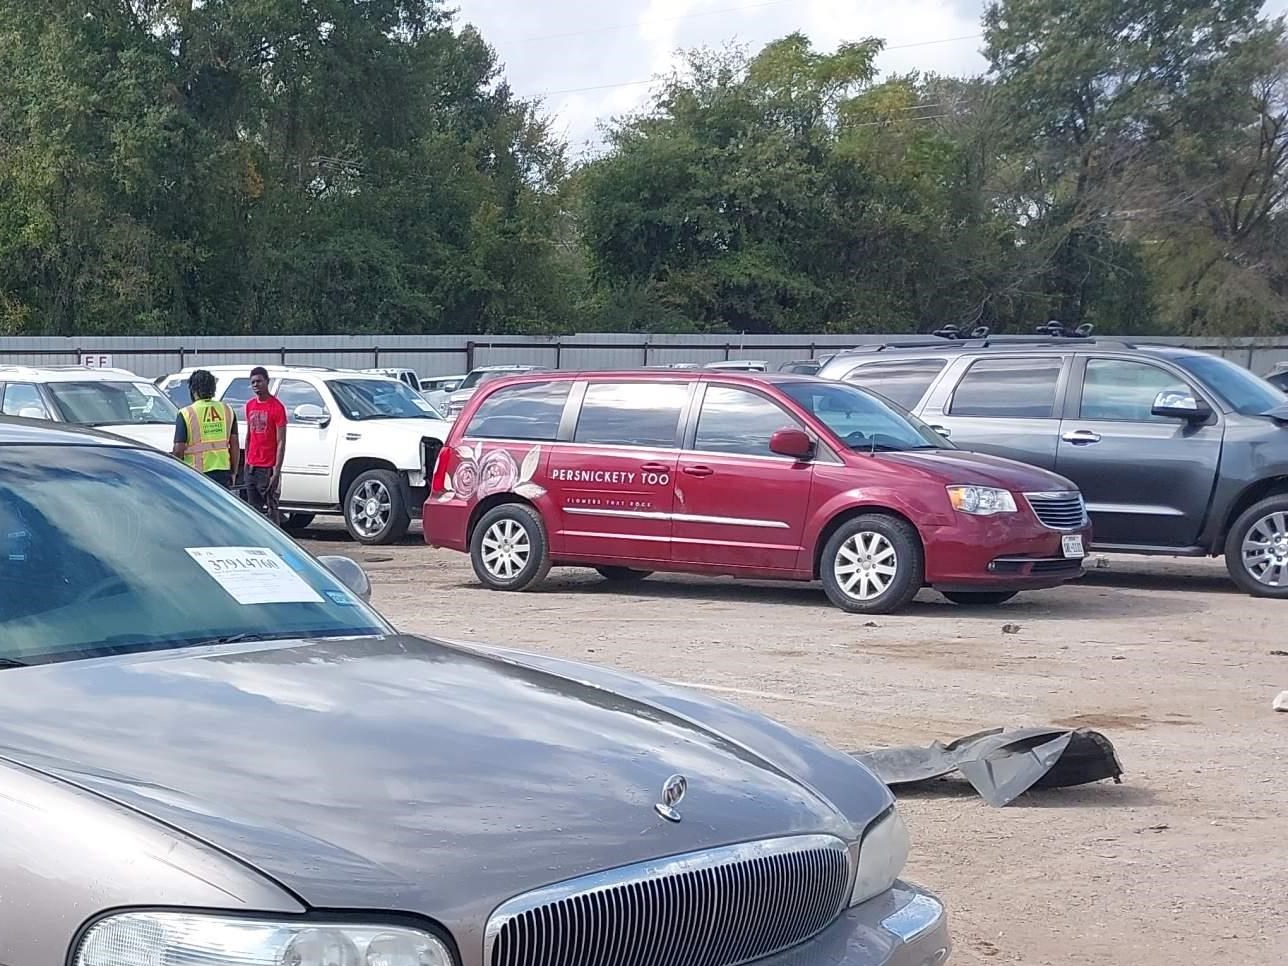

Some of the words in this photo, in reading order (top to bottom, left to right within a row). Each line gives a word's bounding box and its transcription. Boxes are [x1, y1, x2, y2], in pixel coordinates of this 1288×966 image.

[552, 469, 635, 483] PERSNICKETY
[641, 472, 669, 485] TOO
[208, 558, 280, 571] 37914760
